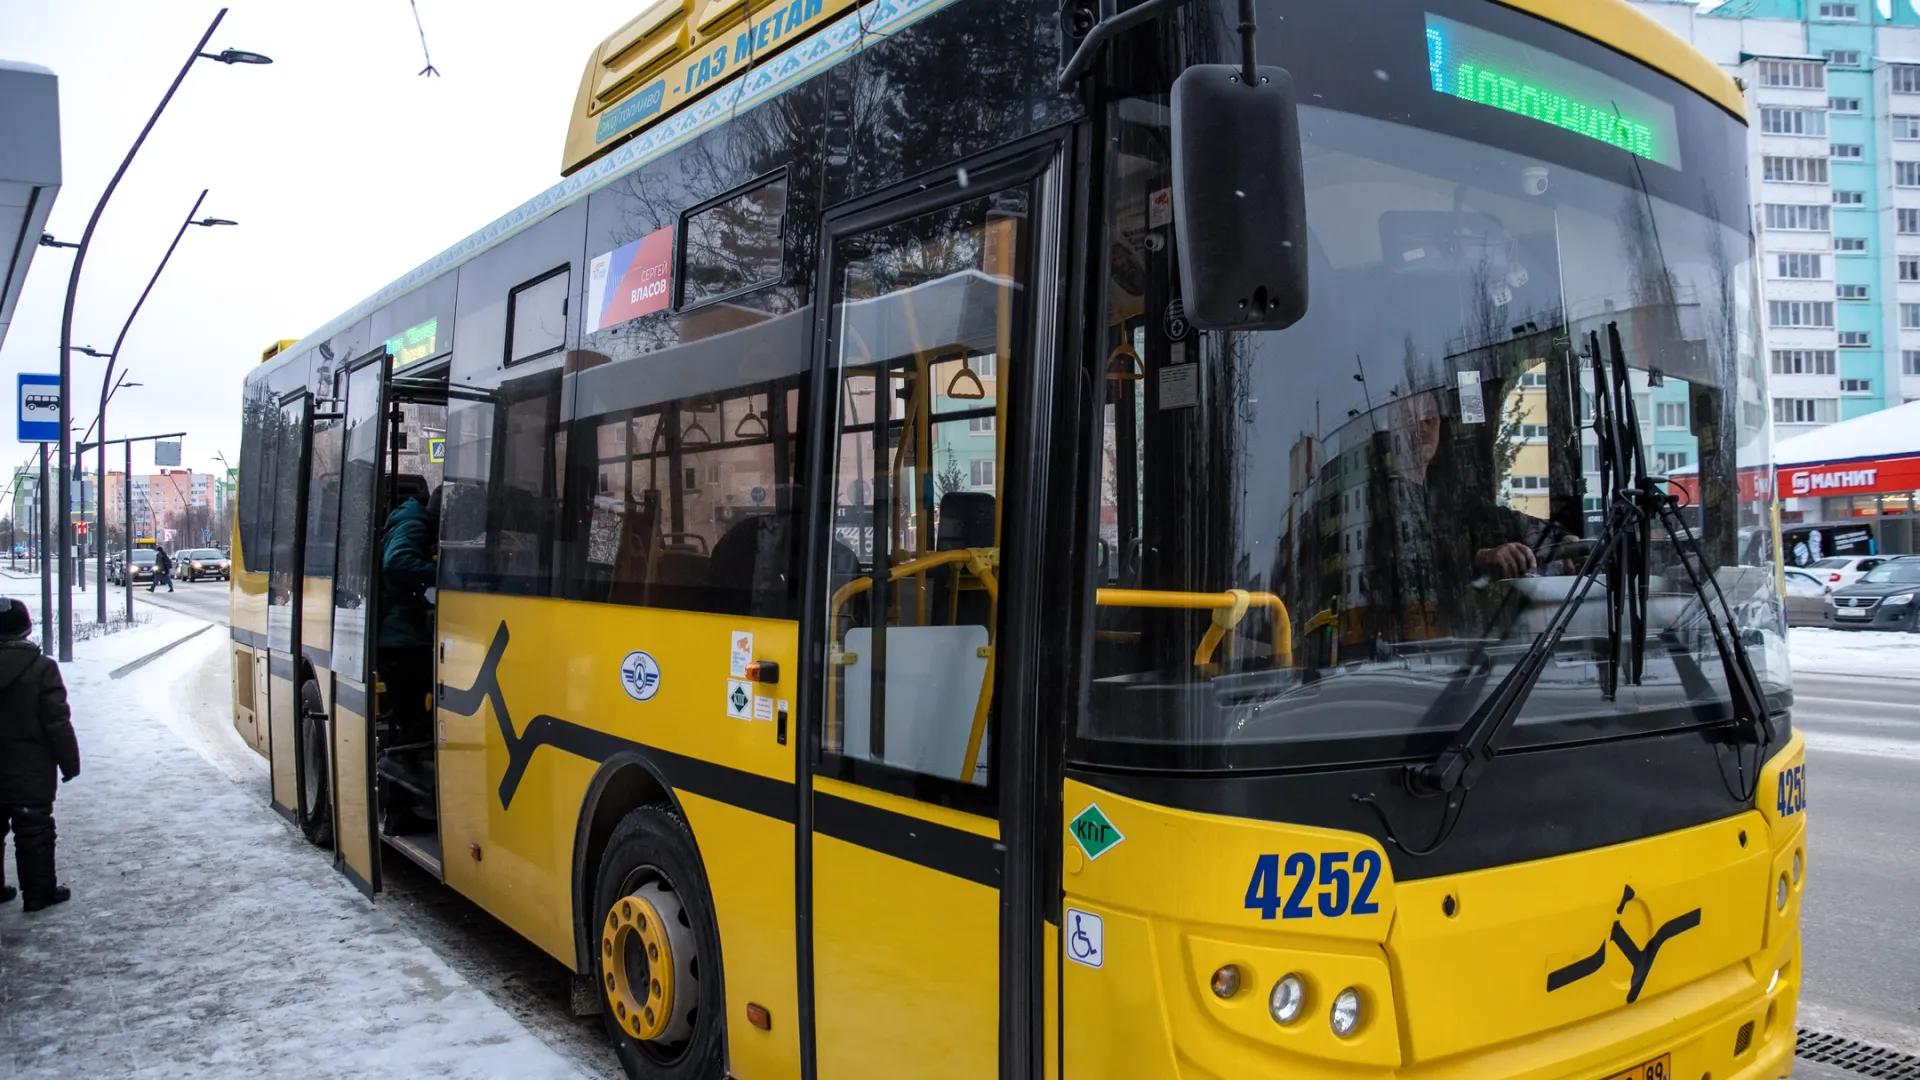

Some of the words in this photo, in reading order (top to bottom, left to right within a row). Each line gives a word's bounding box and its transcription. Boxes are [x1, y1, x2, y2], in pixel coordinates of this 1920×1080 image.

[619, 89, 660, 125] ТОПЛИВО
[685, 45, 728, 94] ГАЗ
[641, 260, 668, 283] СЕРГЕЙ
[630, 279, 667, 304] ВЛАСОВ
[1810, 468, 1877, 489] МАГНИТ
[1077, 819, 1112, 844] КПГ
[1244, 850, 1382, 920] 4252
